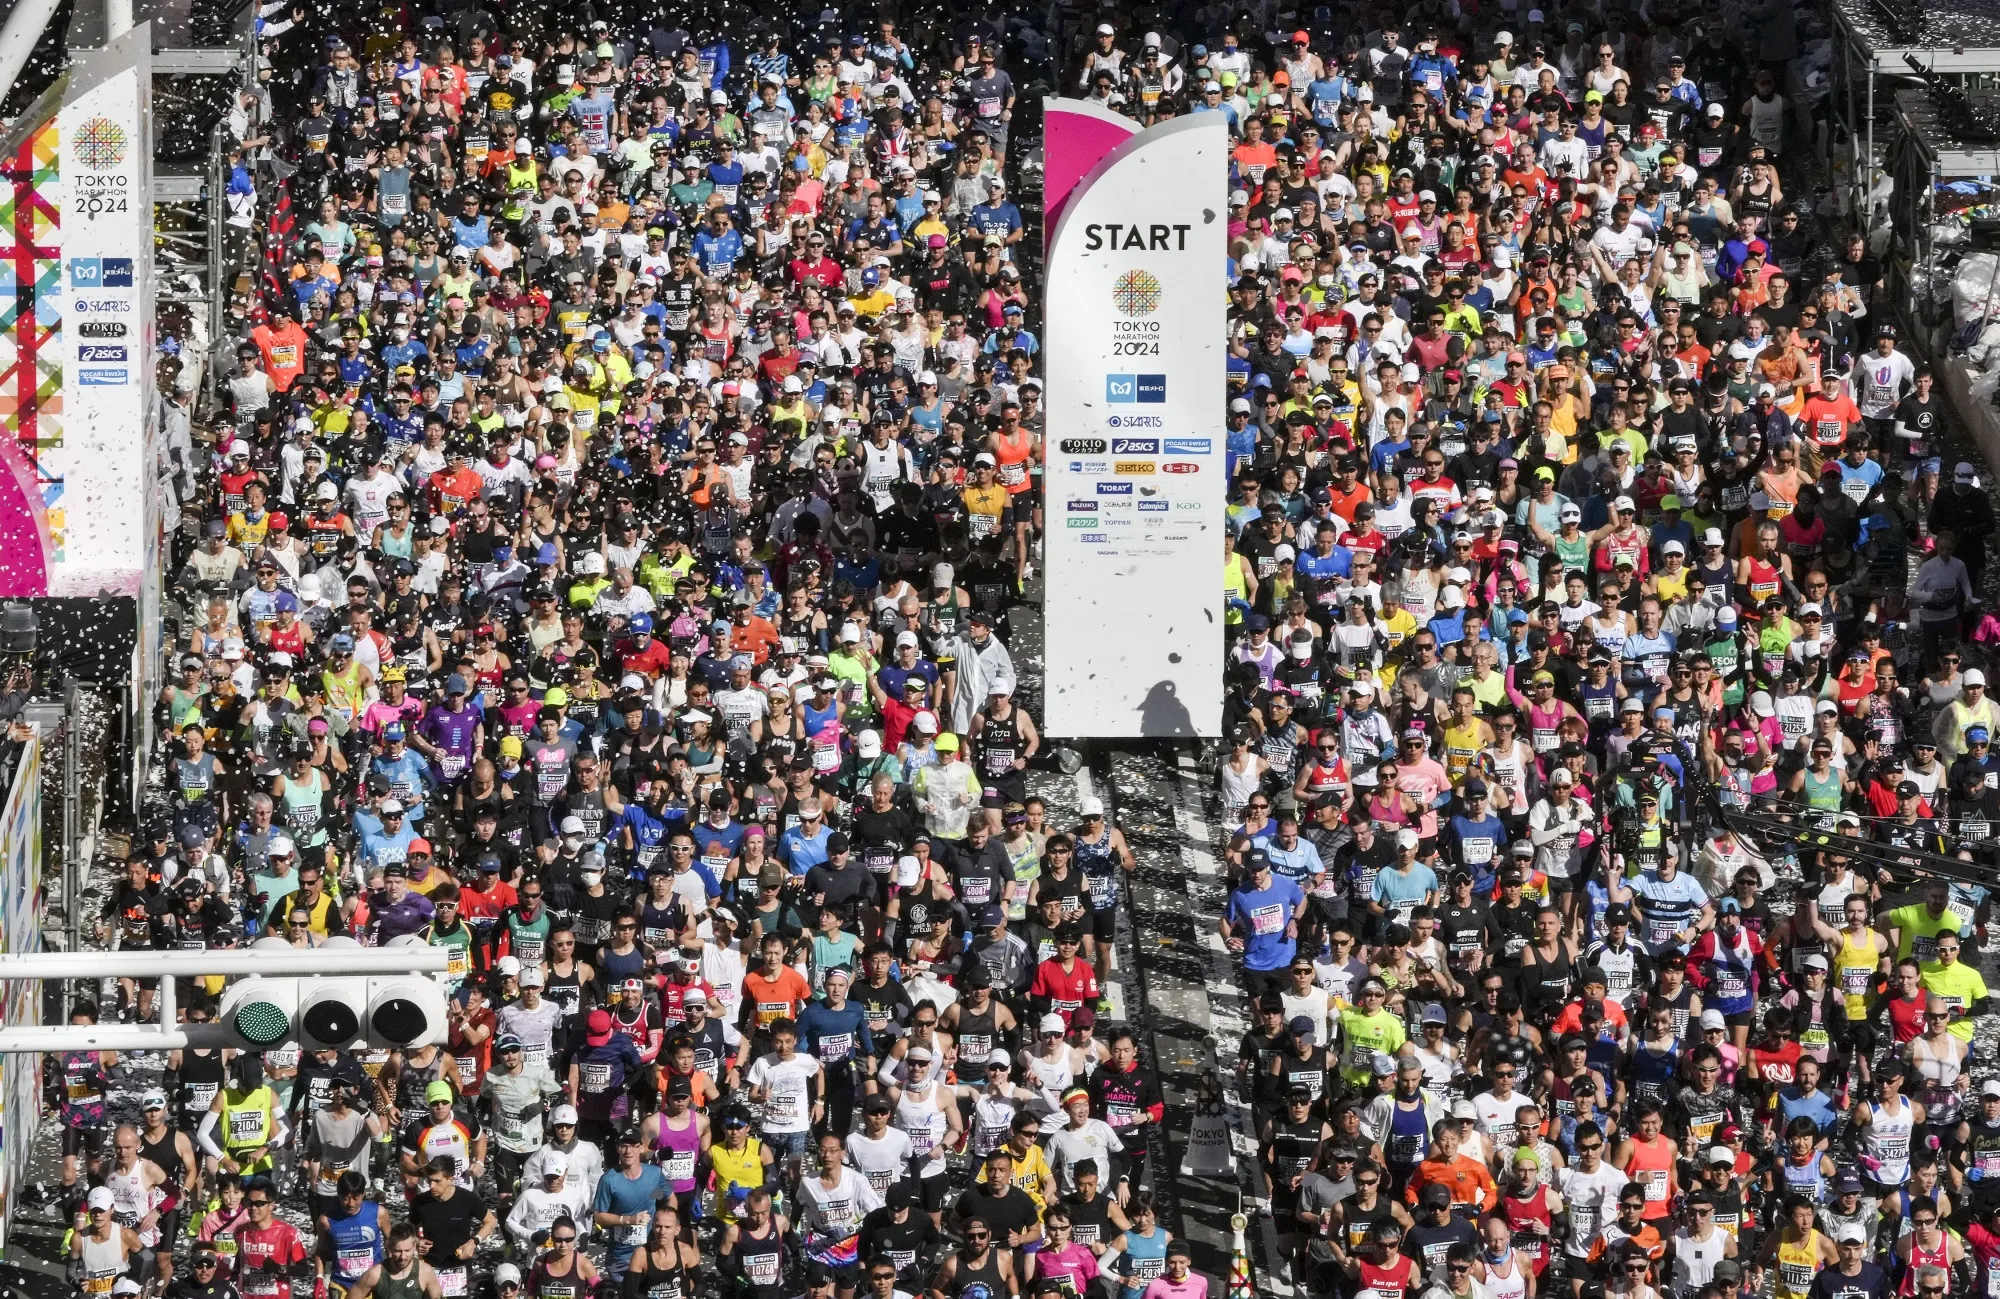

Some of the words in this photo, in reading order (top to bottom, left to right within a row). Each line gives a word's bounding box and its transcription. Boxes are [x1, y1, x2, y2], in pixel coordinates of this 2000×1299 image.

[75, 176, 128, 186] TOKYO
[76, 198, 128, 212] 2024
[1085, 224, 1191, 250] START
[1114, 322, 1160, 332] TOKYO
[95, 350, 123, 358] asics
[1114, 342, 1160, 356] 2024
[1128, 441, 1154, 451] asics
[1116, 464, 1154, 472] SEIKO
[827, 1044, 847, 1055] 60327
[1192, 1128, 1224, 1138] TOKYO
[670, 1162, 690, 1170] 80569
[827, 1210, 849, 1220] 20489
[752, 1266, 773, 1275] 10768
[1786, 1273, 1808, 1284] 11129
